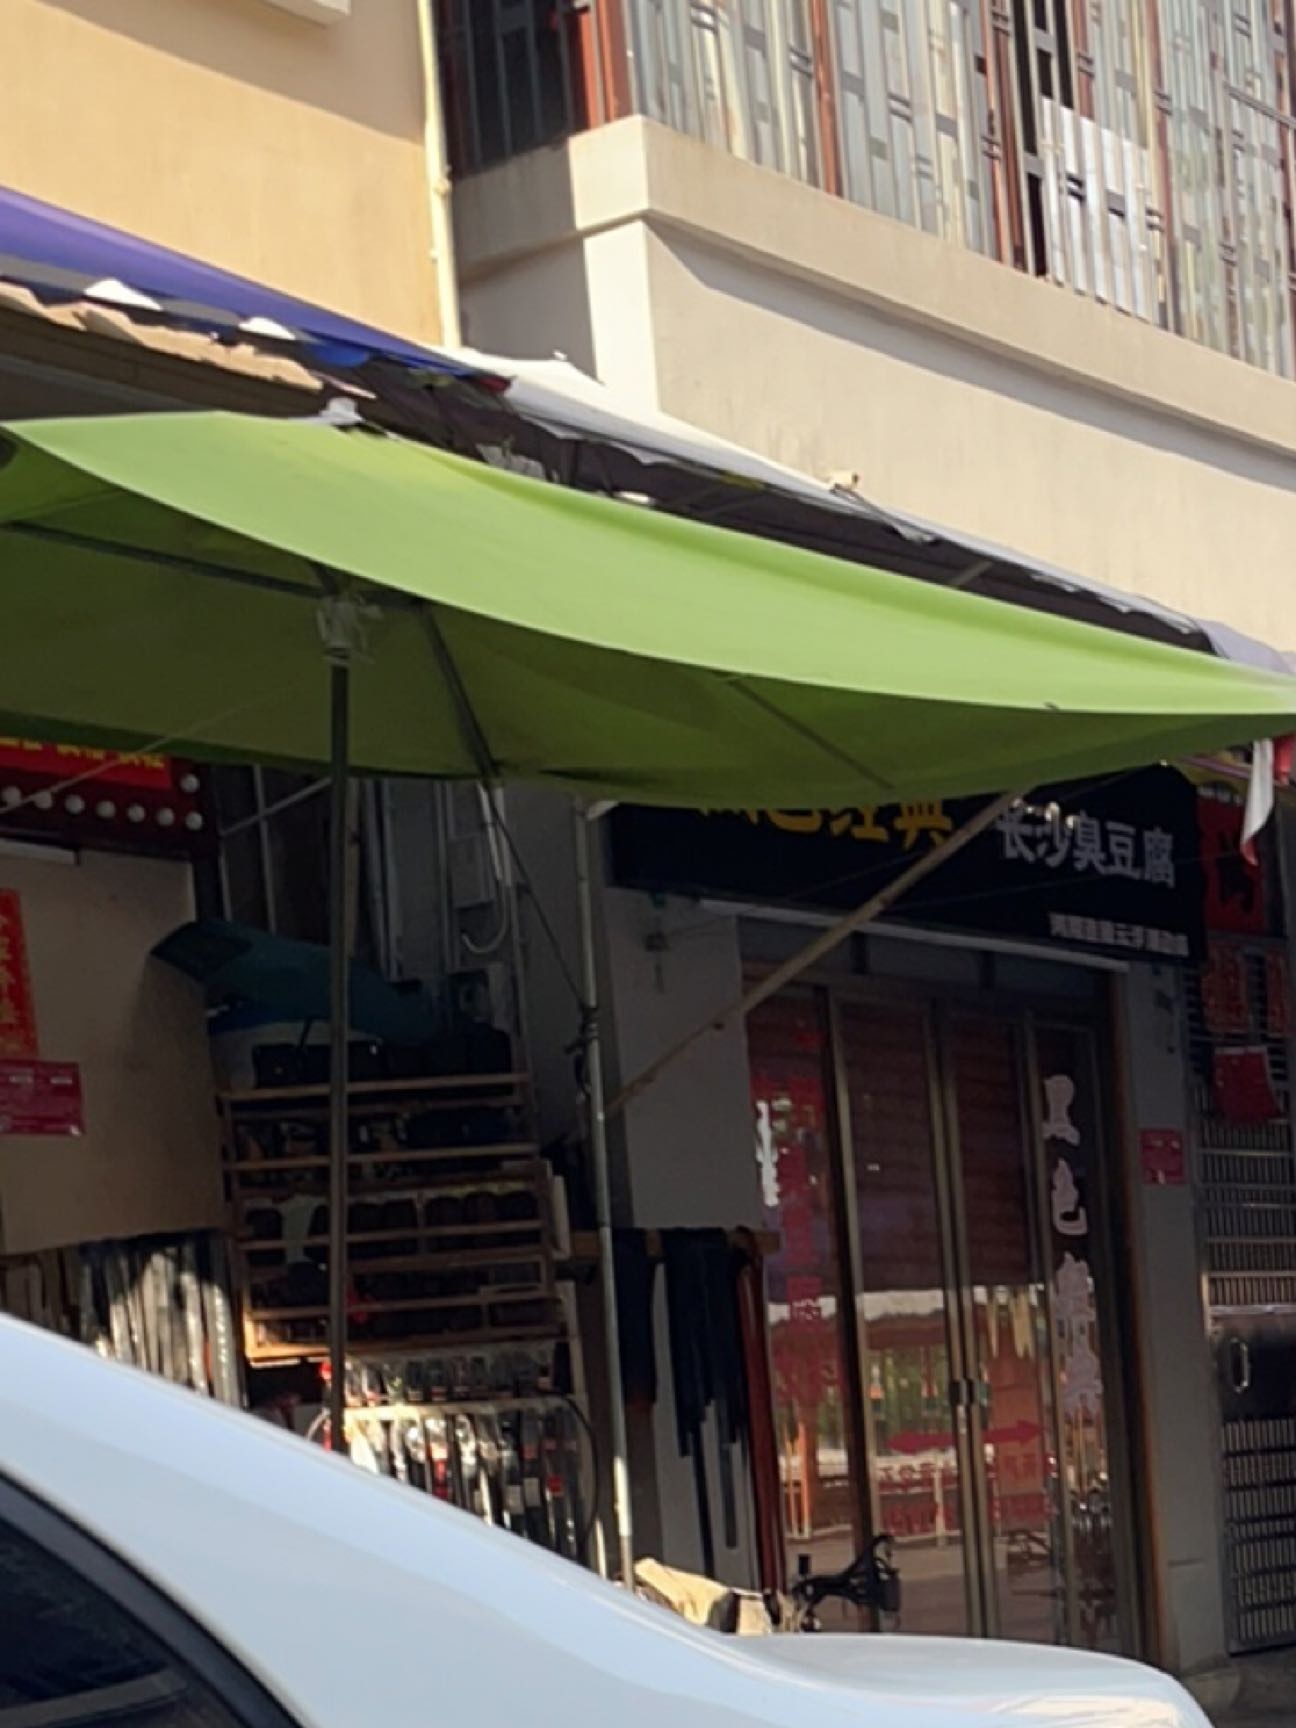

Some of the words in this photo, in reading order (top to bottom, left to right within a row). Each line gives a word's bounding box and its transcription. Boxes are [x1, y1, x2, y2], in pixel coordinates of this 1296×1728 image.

[995, 801, 1177, 889] 长沙臭豆腐
